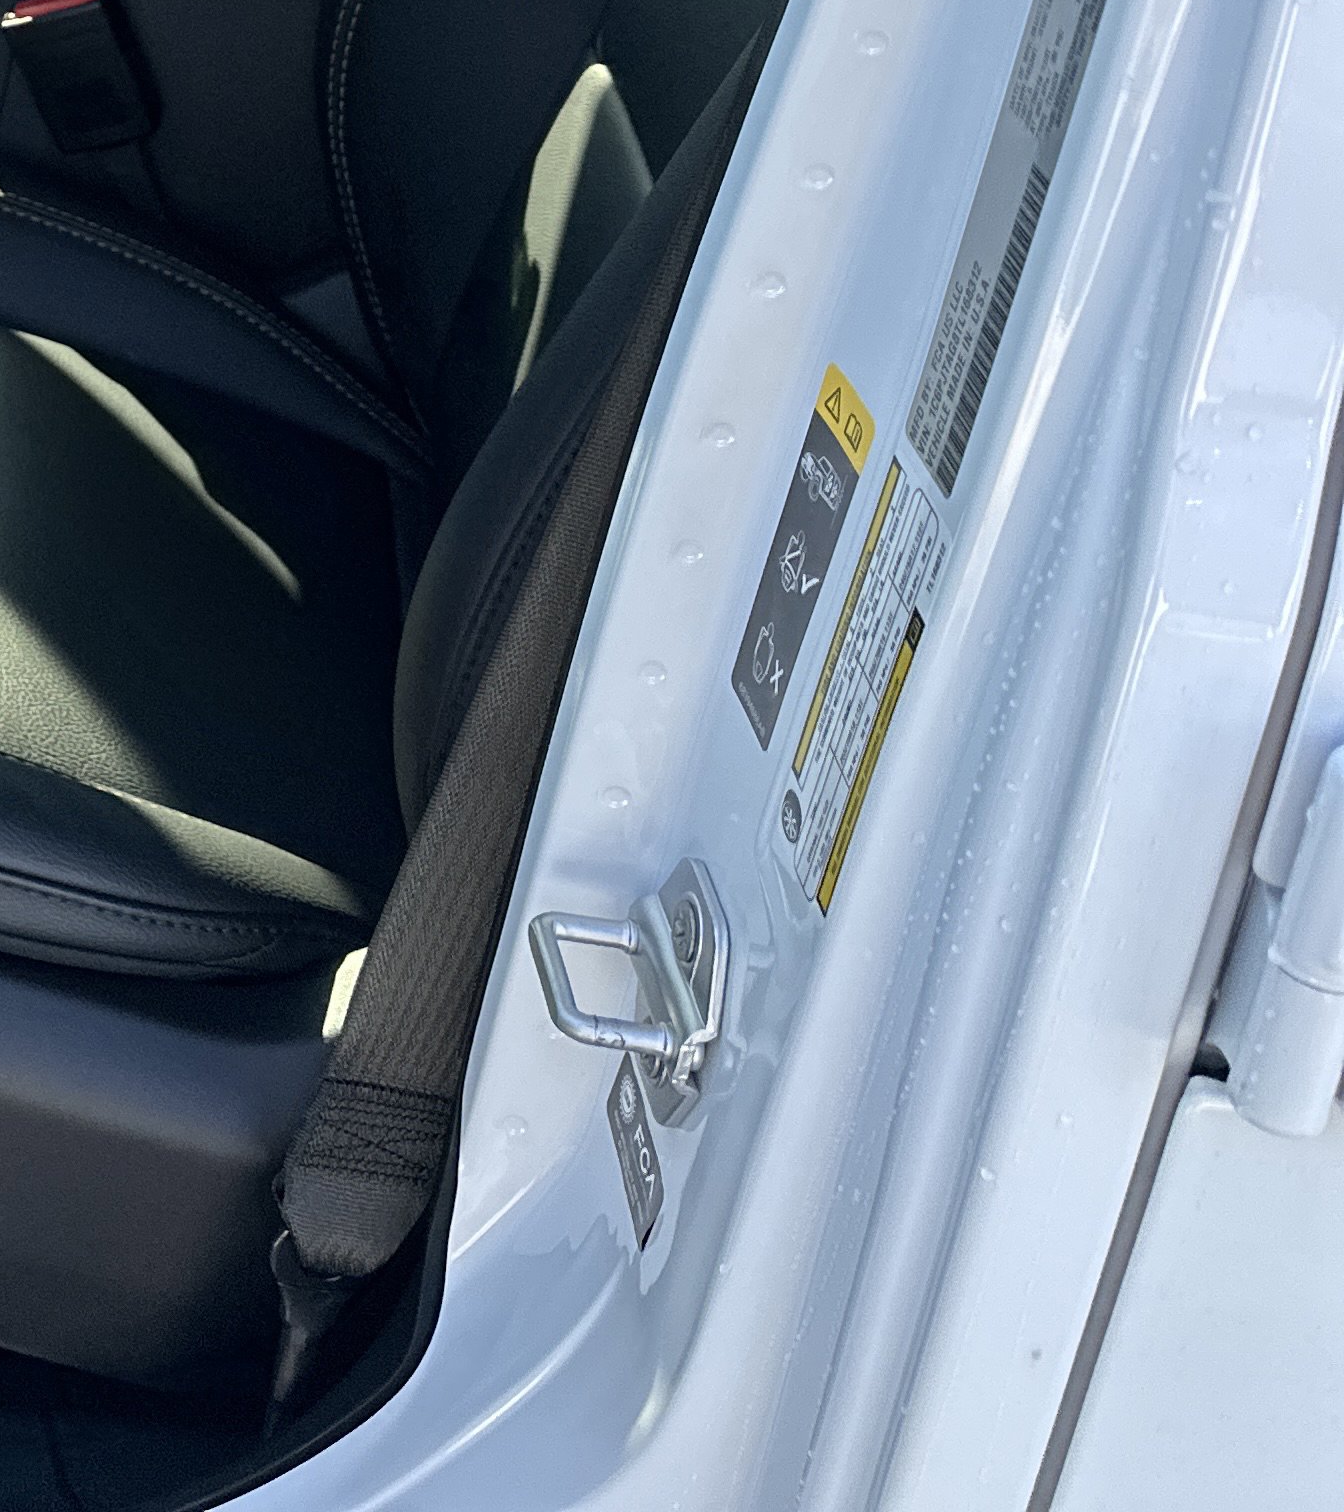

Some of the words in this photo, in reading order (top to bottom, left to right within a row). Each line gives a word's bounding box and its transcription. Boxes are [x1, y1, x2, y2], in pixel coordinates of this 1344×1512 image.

[908, 403, 924, 444] MFD
[930, 337, 944, 374] FCA
[941, 310, 953, 339] US
[949, 277, 963, 313] LLC
[925, 400, 949, 470] VEHICLE
[946, 350, 965, 402] MADE
